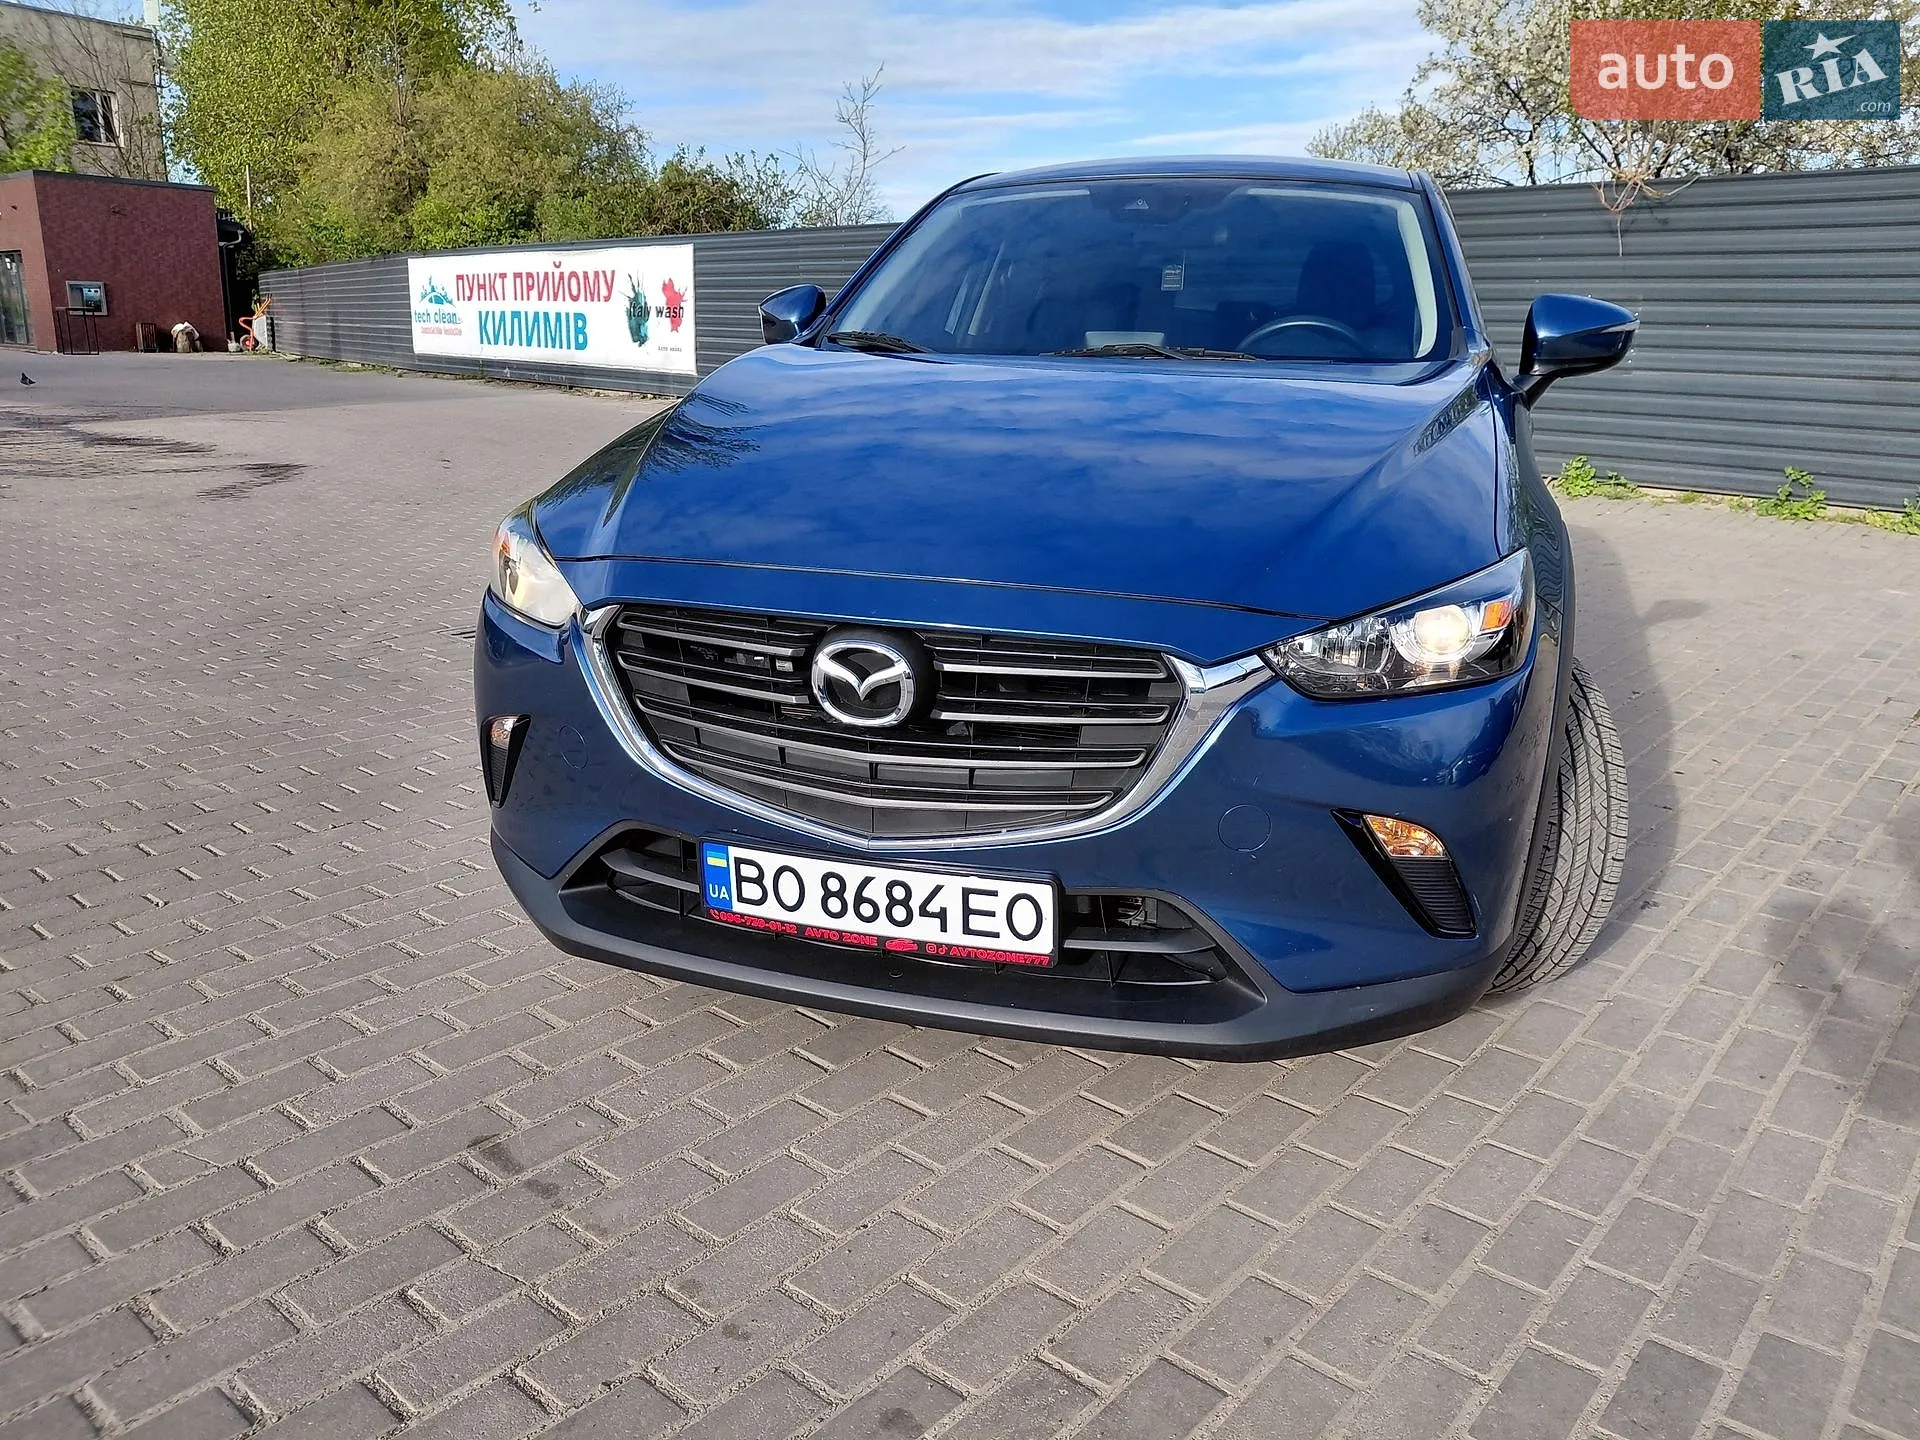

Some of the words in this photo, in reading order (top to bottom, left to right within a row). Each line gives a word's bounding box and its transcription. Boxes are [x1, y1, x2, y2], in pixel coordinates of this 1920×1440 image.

[455, 271, 507, 302] ПУНКТ
[513, 261, 616, 303] ПРИЙОМУ
[414, 309, 431, 323] tech
[434, 308, 457, 324] clean
[478, 310, 588, 351] КИЛИМІВ
[655, 304, 684, 319] wash
[709, 883, 730, 901] UA
[733, 856, 806, 913] BO
[820, 870, 948, 933] 8684
[962, 886, 1044, 942] EO
[804, 926, 840, 941] AVTO
[842, 932, 878, 946] ZONE
[949, 946, 1050, 966] AVTOZONE777
